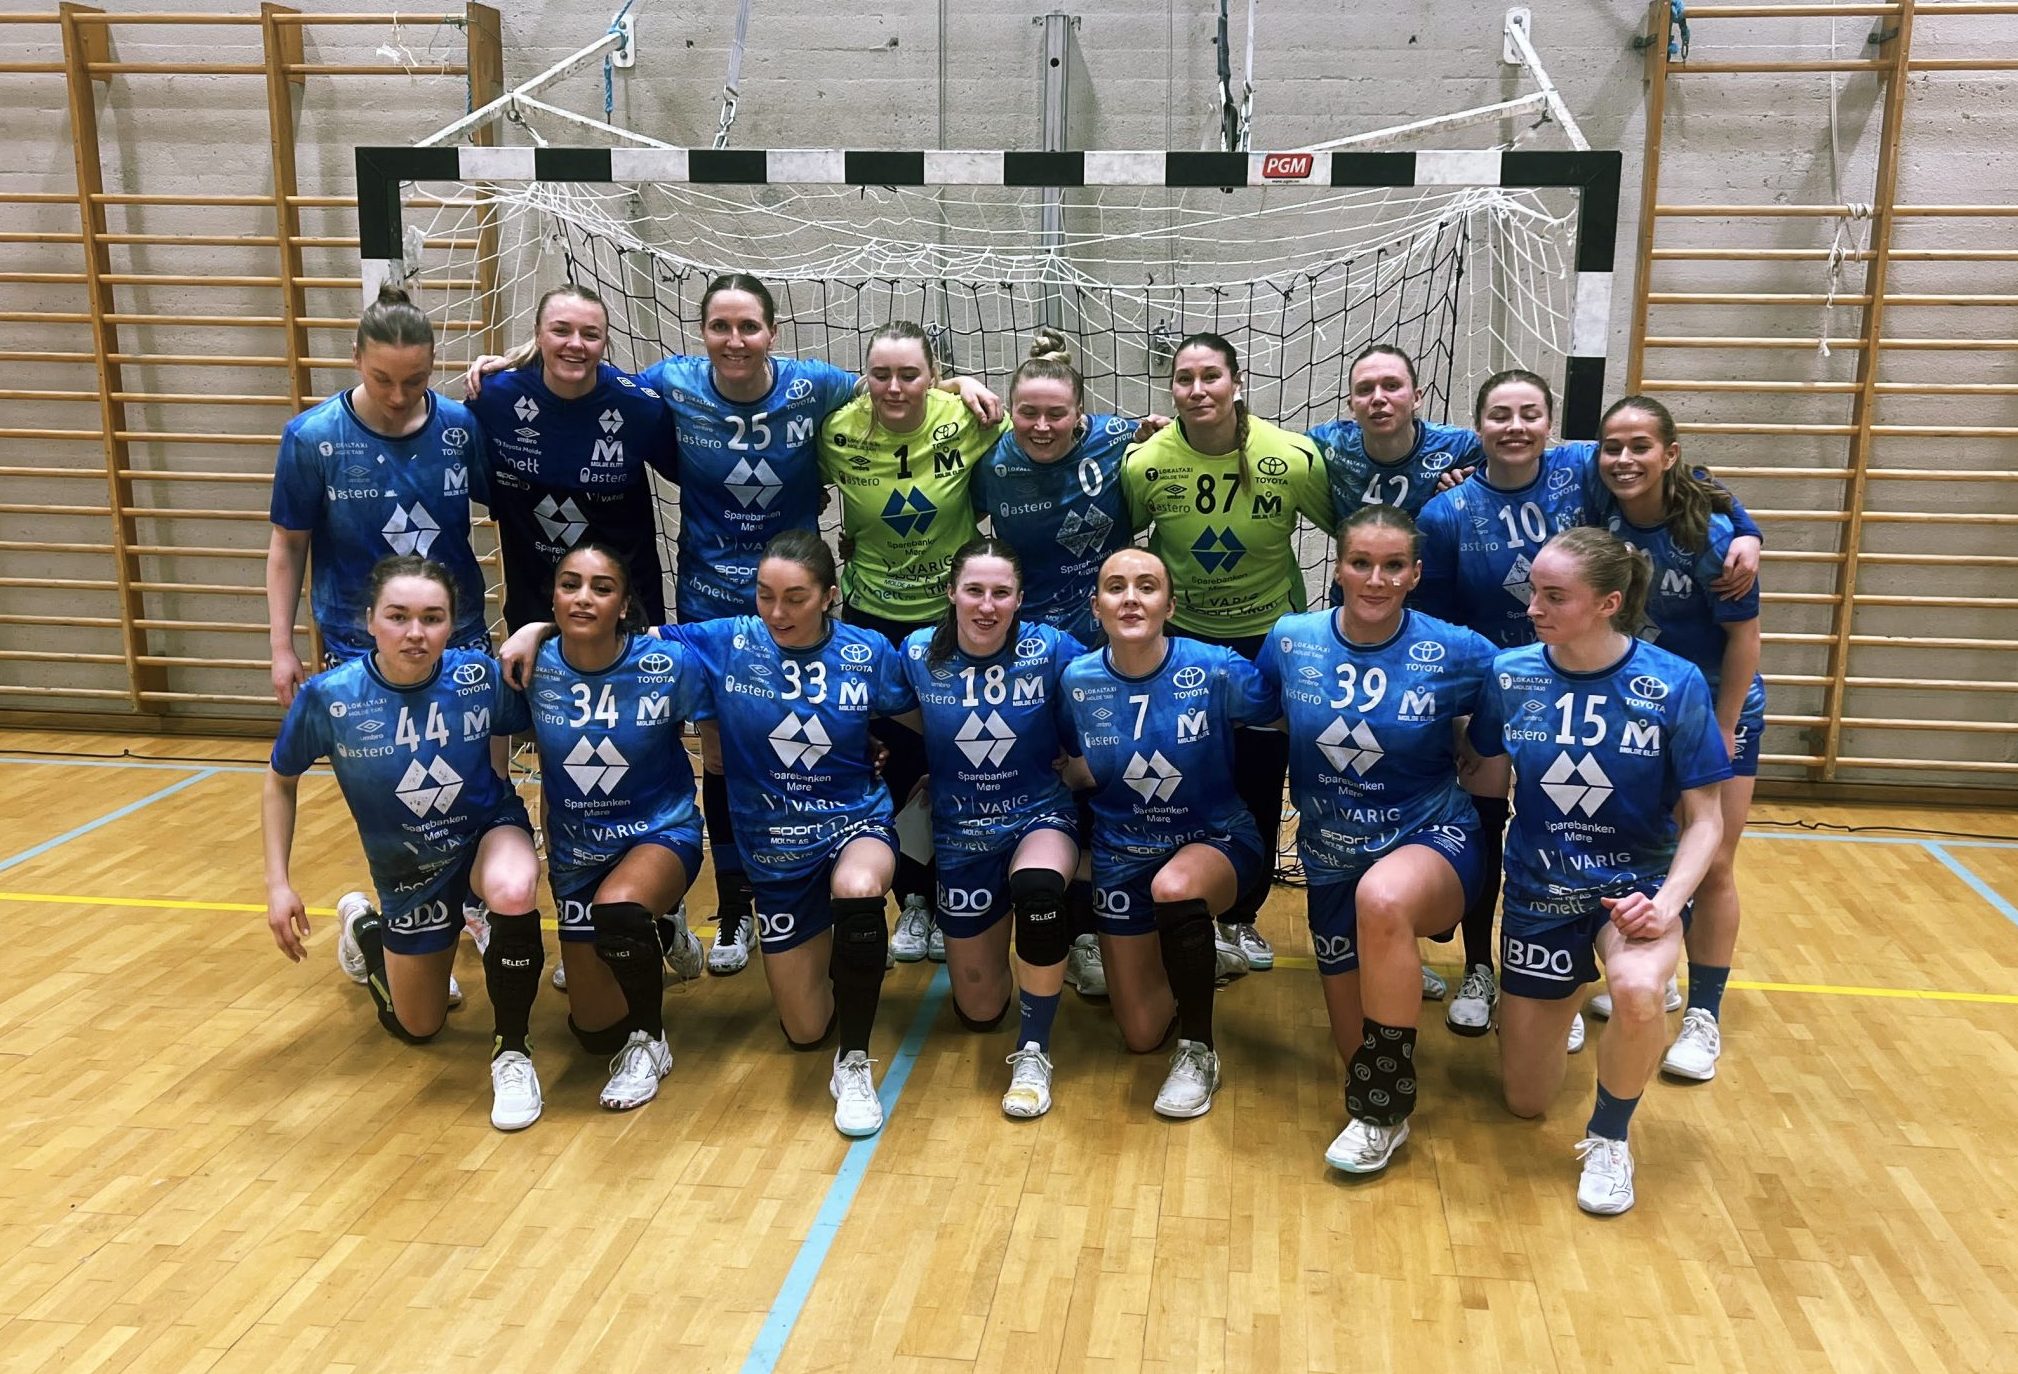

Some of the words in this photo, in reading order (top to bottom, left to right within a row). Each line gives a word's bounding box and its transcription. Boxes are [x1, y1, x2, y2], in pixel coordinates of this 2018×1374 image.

[1267, 158, 1307, 174] PGM
[787, 397, 816, 411] TOYOTA
[517, 436, 538, 445] umbro
[725, 412, 772, 452] 25
[682, 434, 722, 449] astero
[592, 439, 624, 462] M
[893, 444, 913, 480] 1
[591, 472, 628, 484] astero
[1254, 477, 1288, 486] TOYOTA
[338, 486, 379, 500] astero
[1195, 473, 1242, 515] 87
[1361, 473, 1409, 509] 42
[1548, 483, 1581, 502] TOYOTA
[1010, 501, 1052, 515] astero
[1498, 501, 1547, 549] 10
[535, 541, 567, 555] Spareb
[714, 565, 758, 576] spor
[839, 663, 874, 674] TOYOTA
[1013, 657, 1050, 668] TOYOTA
[1404, 663, 1445, 674] TOYOTA
[637, 675, 676, 686] TOYOTA
[781, 659, 828, 705] 33
[958, 664, 1007, 707] 18
[1012, 675, 1046, 701] M
[1330, 662, 1388, 713] 39
[1512, 676, 1552, 685] LOKALTAXI
[456, 683, 491, 698] TOYOTA
[734, 682, 776, 700] astero
[840, 680, 870, 705] M
[920, 690, 957, 705] astero
[1173, 687, 1210, 701] TOYOTA
[569, 682, 620, 730] 34
[636, 694, 672, 721] M
[1398, 689, 1436, 716] M
[1624, 695, 1667, 714] TOYOTA
[537, 712, 565, 727] stero
[1128, 693, 1150, 742] 7
[1177, 709, 1208, 738] M
[1554, 692, 1608, 747] 15
[394, 700, 450, 755] 44
[1511, 723, 1547, 742] astero
[1621, 719, 1661, 749] M
[350, 743, 394, 759] astero
[957, 769, 1019, 784] Sparebanken
[1317, 773, 1385, 791] Sparebanken
[786, 783, 813, 793] Møre
[975, 782, 1002, 792] Møre
[563, 798, 632, 811] Sparebanken
[978, 794, 1029, 815] VARIG
[402, 814, 469, 833] Sparebanken
[1146, 813, 1172, 824] Møre
[1340, 807, 1401, 823] VARIG
[424, 828, 450, 842] Møre
[591, 820, 650, 844] VARIG
[769, 822, 824, 837] sport
[1545, 820, 1616, 835] Sparebanken
[1320, 828, 1372, 846] sport
[1564, 832, 1592, 843] Møre
[572, 847, 616, 864] spor
[1569, 852, 1632, 872] VARIG
[1094, 888, 1131, 914] DO
[1030, 910, 1058, 922] SELECT
[757, 912, 796, 938] DO
[1316, 935, 1351, 957] DO
[502, 957, 531, 968] SELECT
[1507, 937, 1573, 975] BDO
